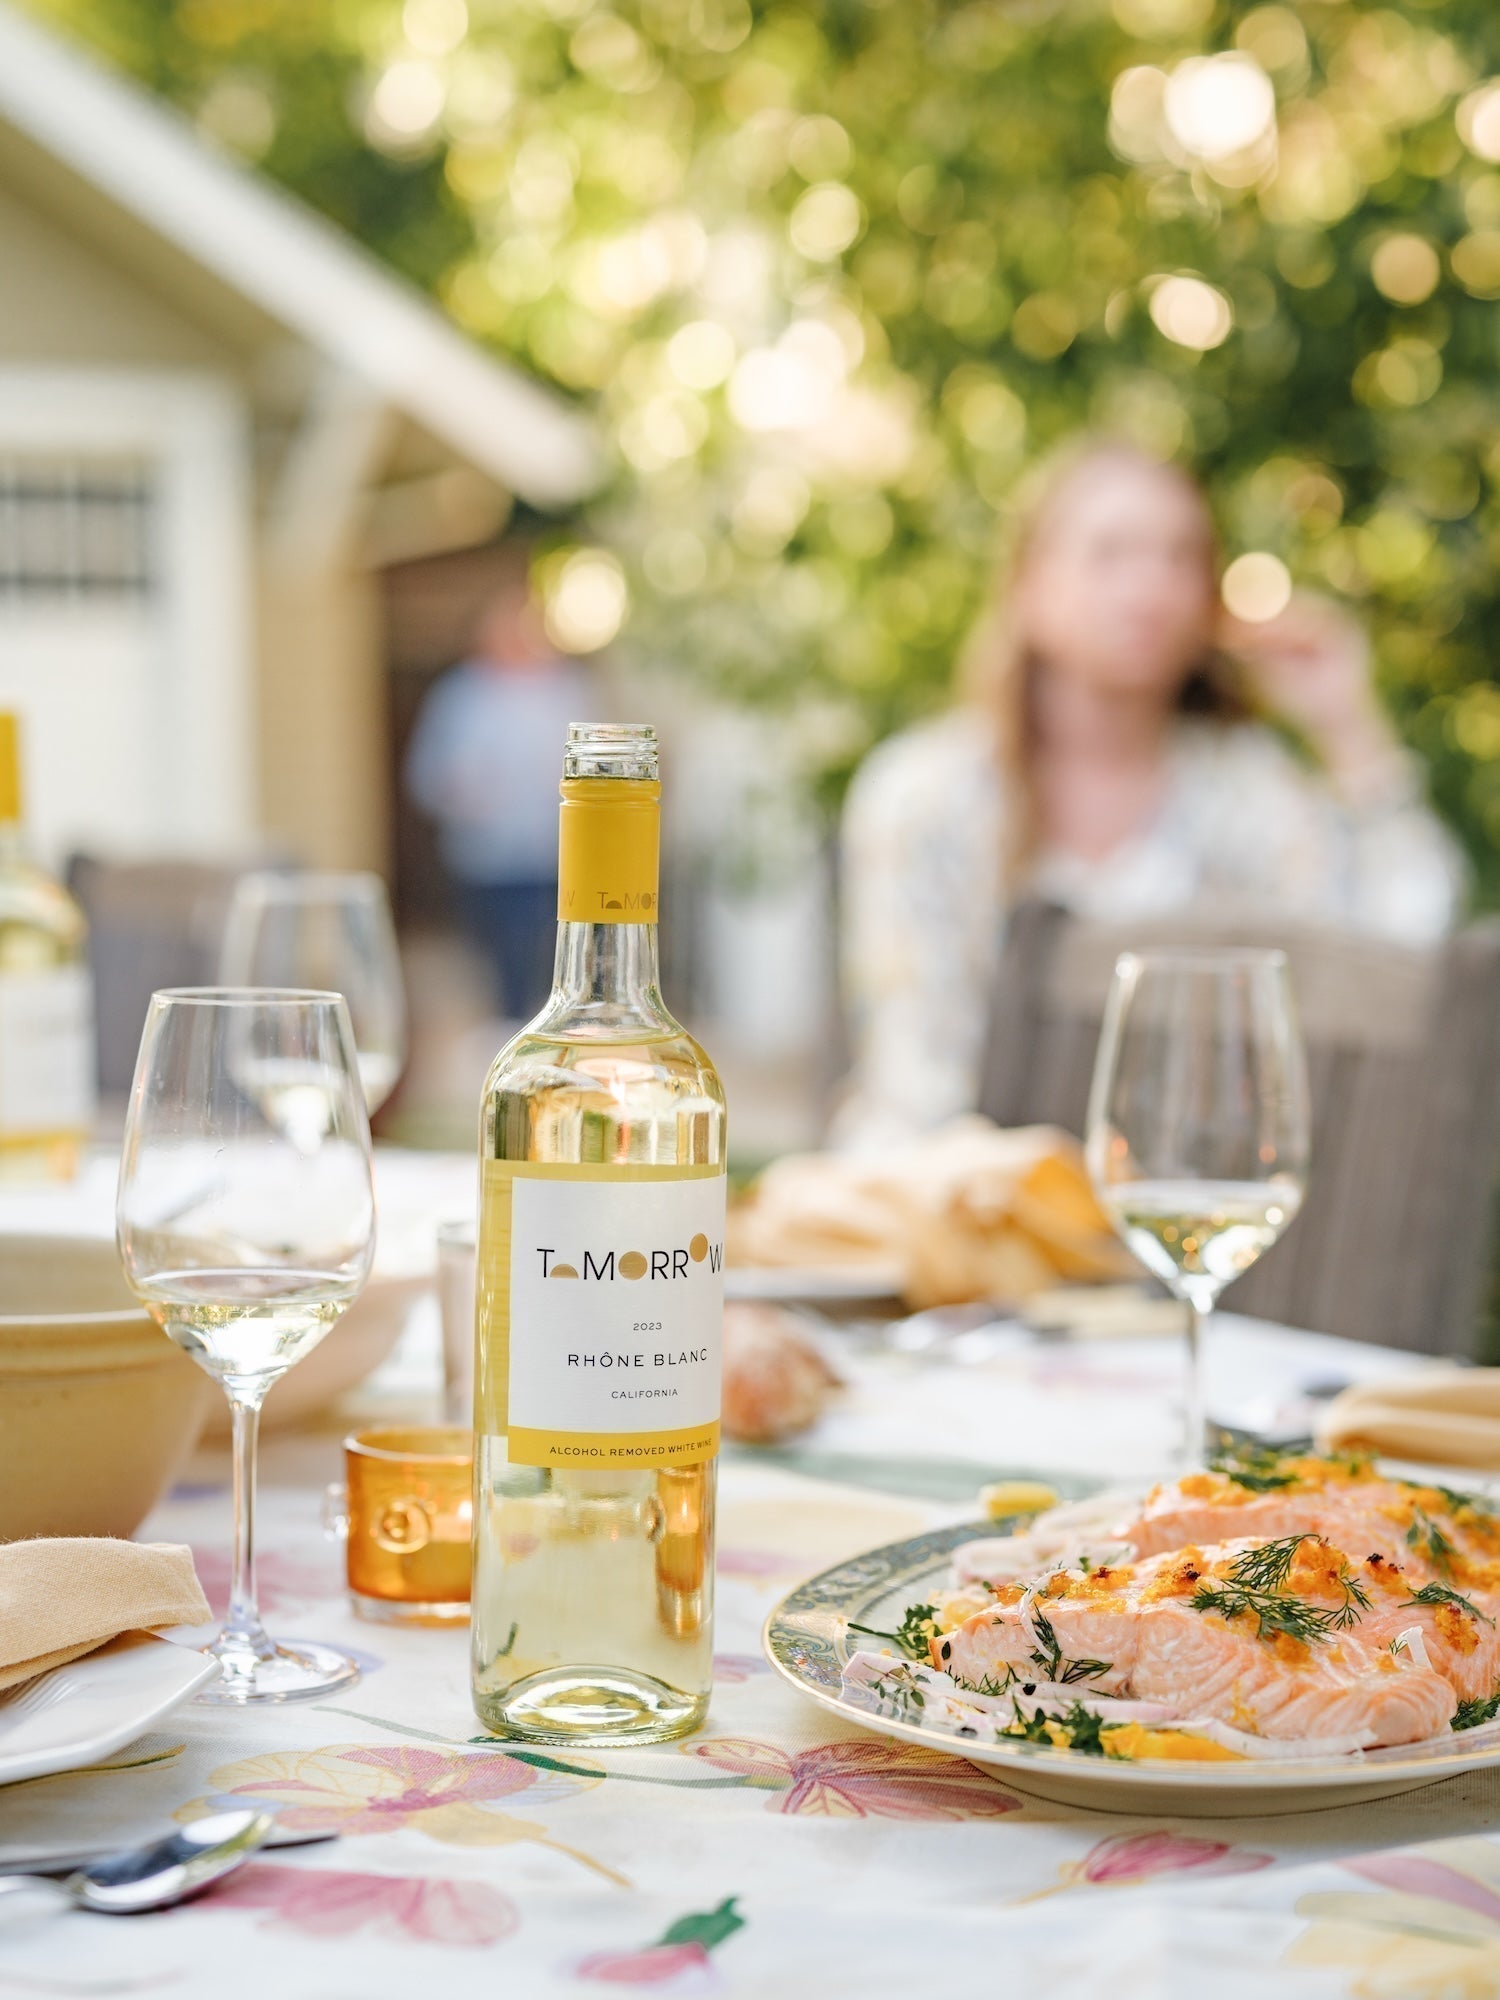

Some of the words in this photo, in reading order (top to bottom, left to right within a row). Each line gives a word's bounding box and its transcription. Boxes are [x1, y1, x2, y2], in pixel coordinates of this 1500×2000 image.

[536, 1233, 722, 1280] TOMORROW
[633, 1322, 662, 1331] 2023
[567, 1352, 644, 1368] RHÔNE
[654, 1348, 707, 1366] BLANC
[611, 1388, 678, 1399] CALIFORNIA
[549, 1446, 605, 1457] ALCOHOL
[610, 1447, 665, 1457] REMOVED
[668, 1442, 696, 1454] WHITE
[697, 1438, 712, 1450] WINE
